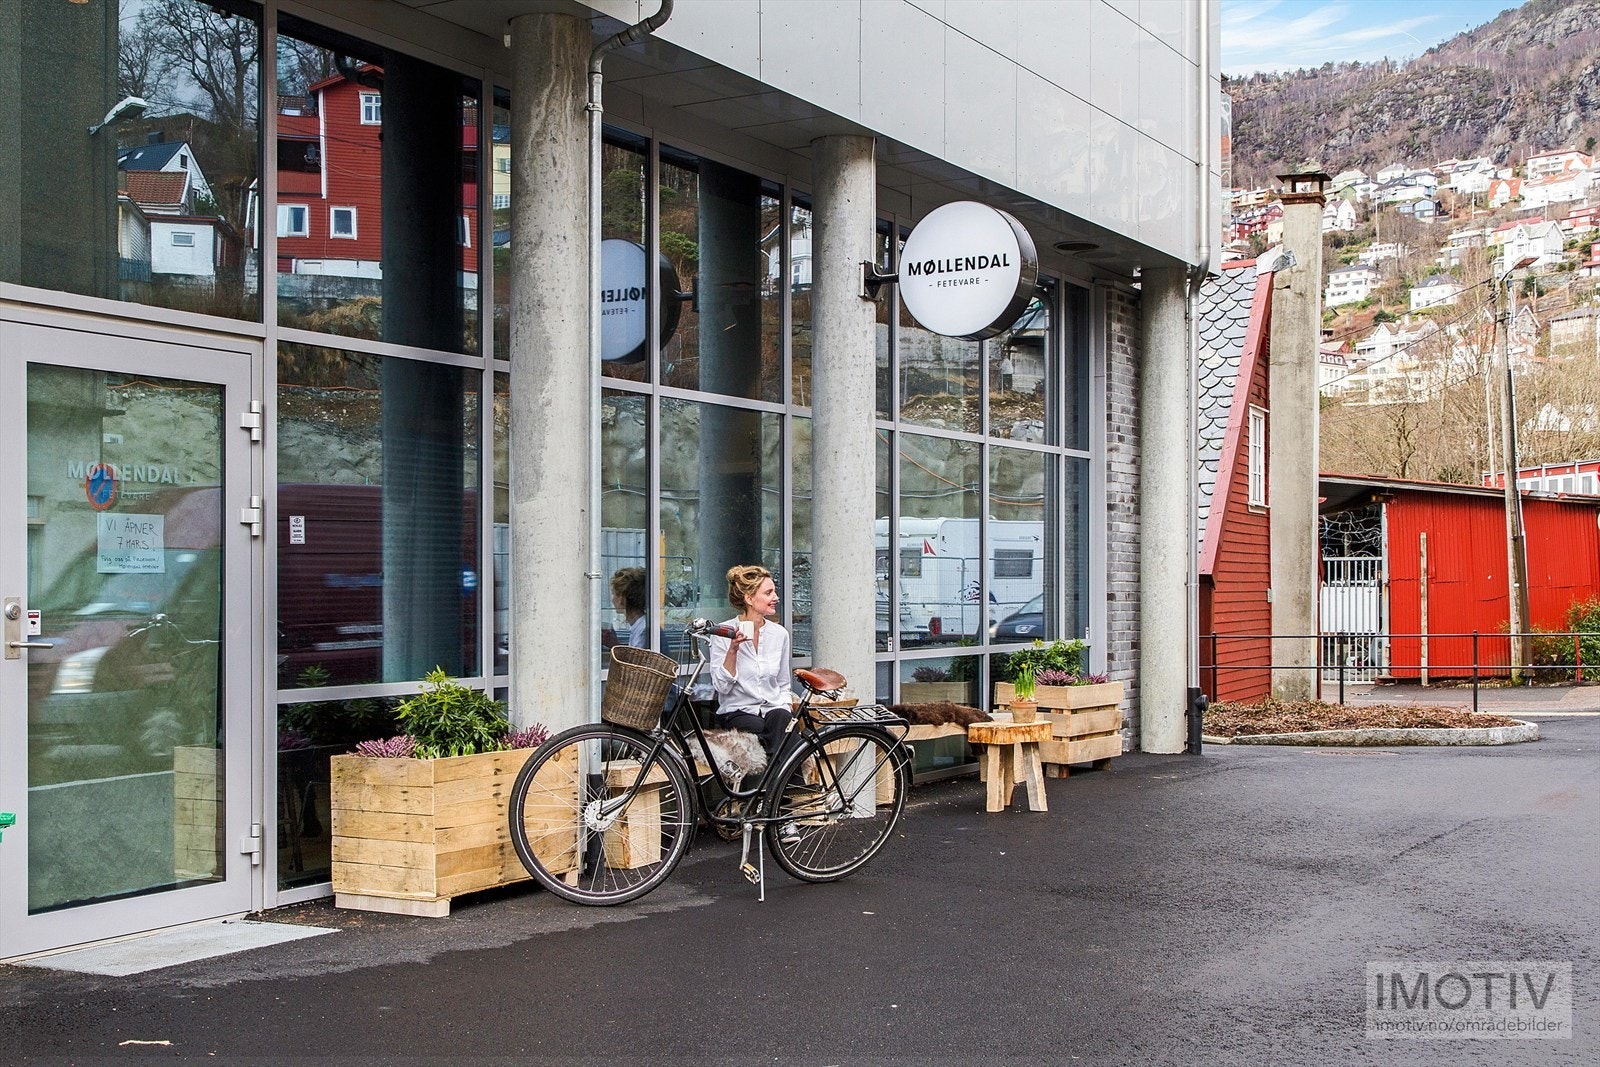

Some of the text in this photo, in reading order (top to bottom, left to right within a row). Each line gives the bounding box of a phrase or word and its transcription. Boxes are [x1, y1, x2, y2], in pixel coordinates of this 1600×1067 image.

[908, 253, 1010, 276] MØLLENDAL
[937, 278, 980, 288] FETEVARE
[105, 517, 158, 536] VI ÅPNER
[117, 536, 123, 549] 7
